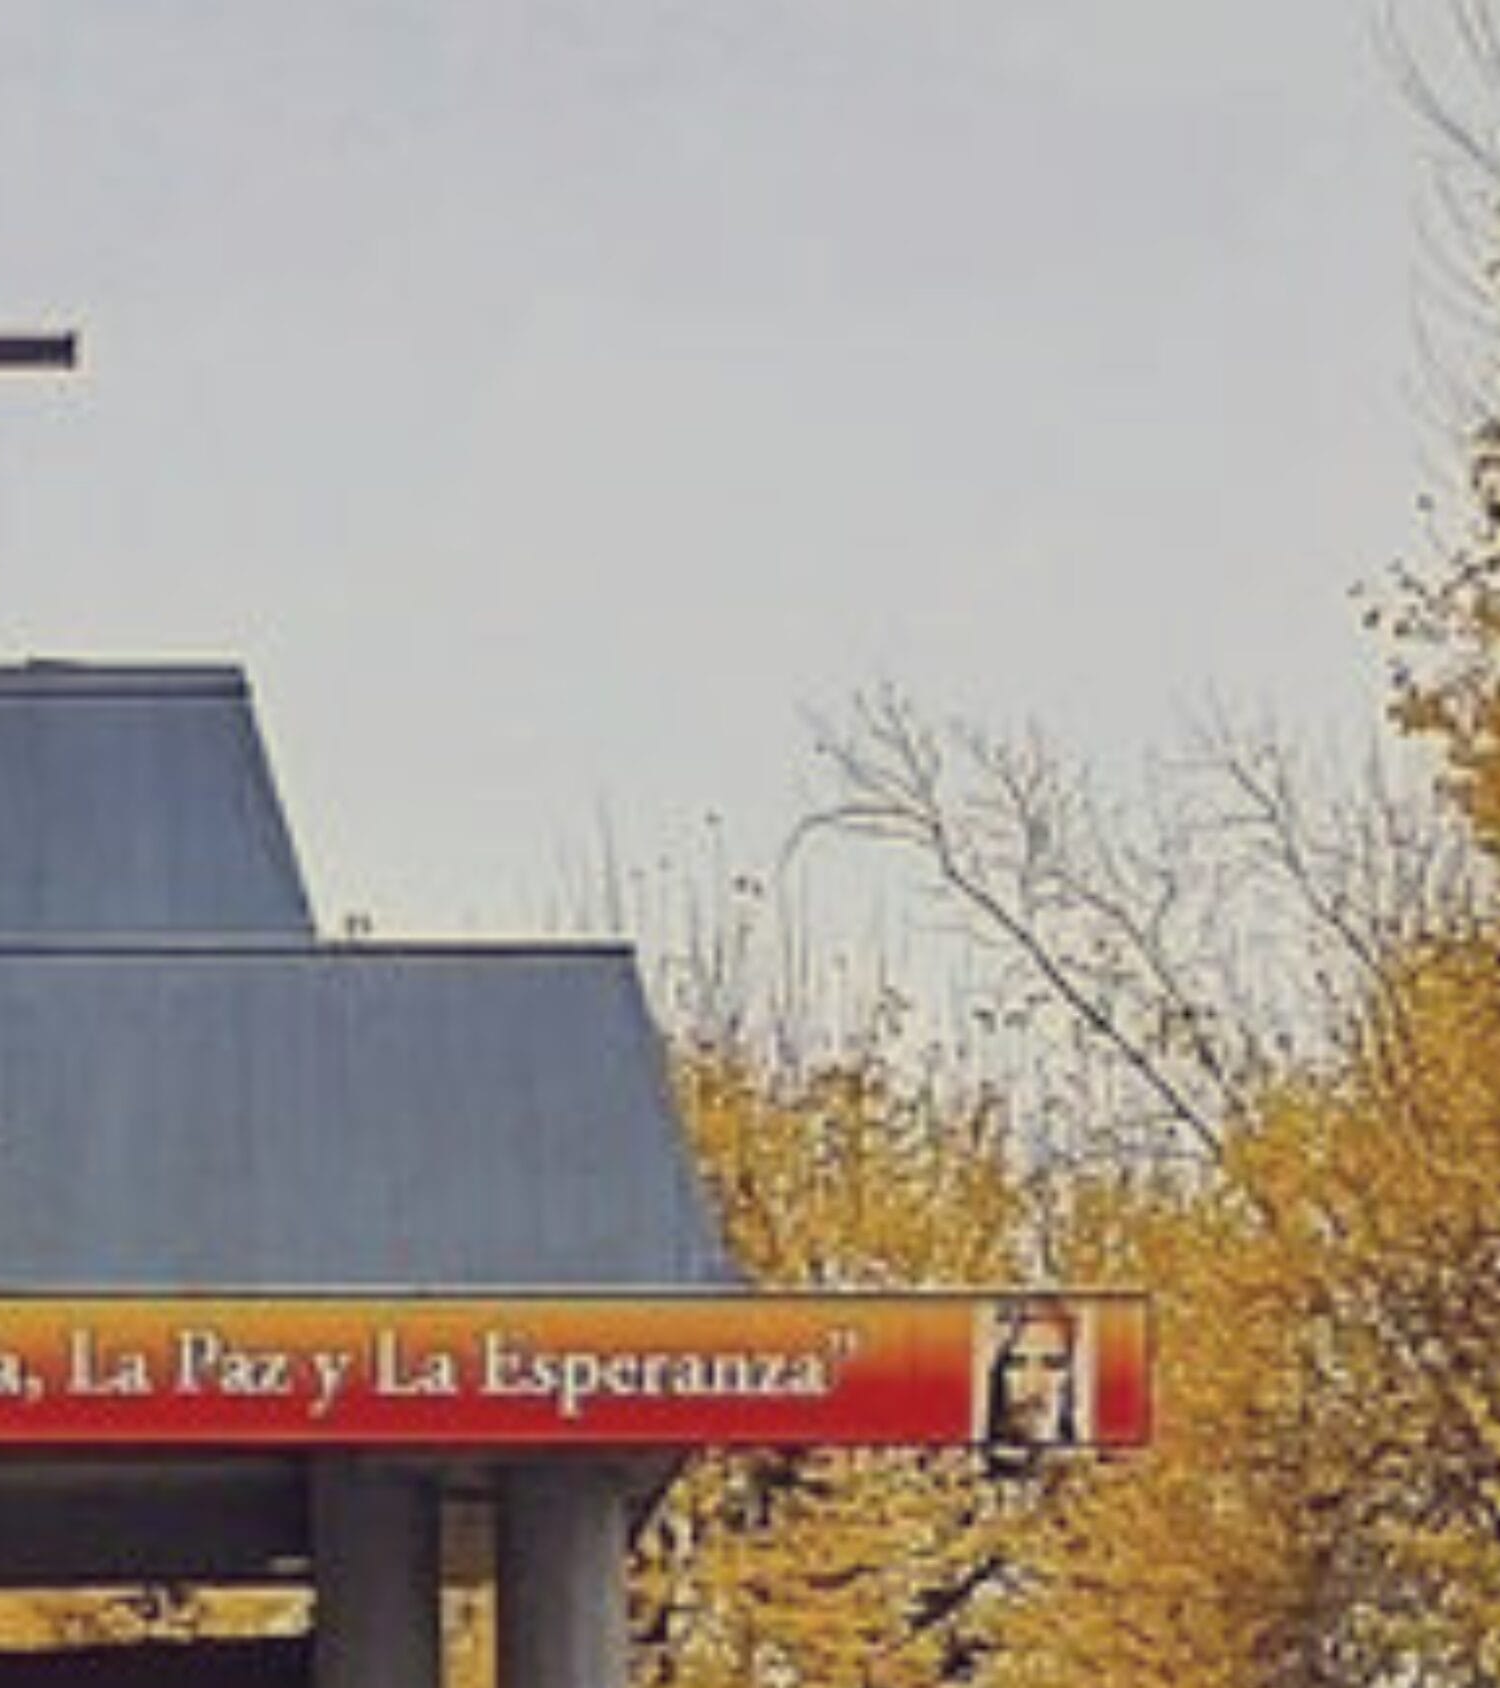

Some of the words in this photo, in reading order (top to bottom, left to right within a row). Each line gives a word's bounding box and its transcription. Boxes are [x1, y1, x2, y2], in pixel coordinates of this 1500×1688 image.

[67, 1327, 152, 1395] La
[176, 1329, 293, 1395] Paz
[307, 1352, 350, 1419] y
[375, 1328, 457, 1395] La
